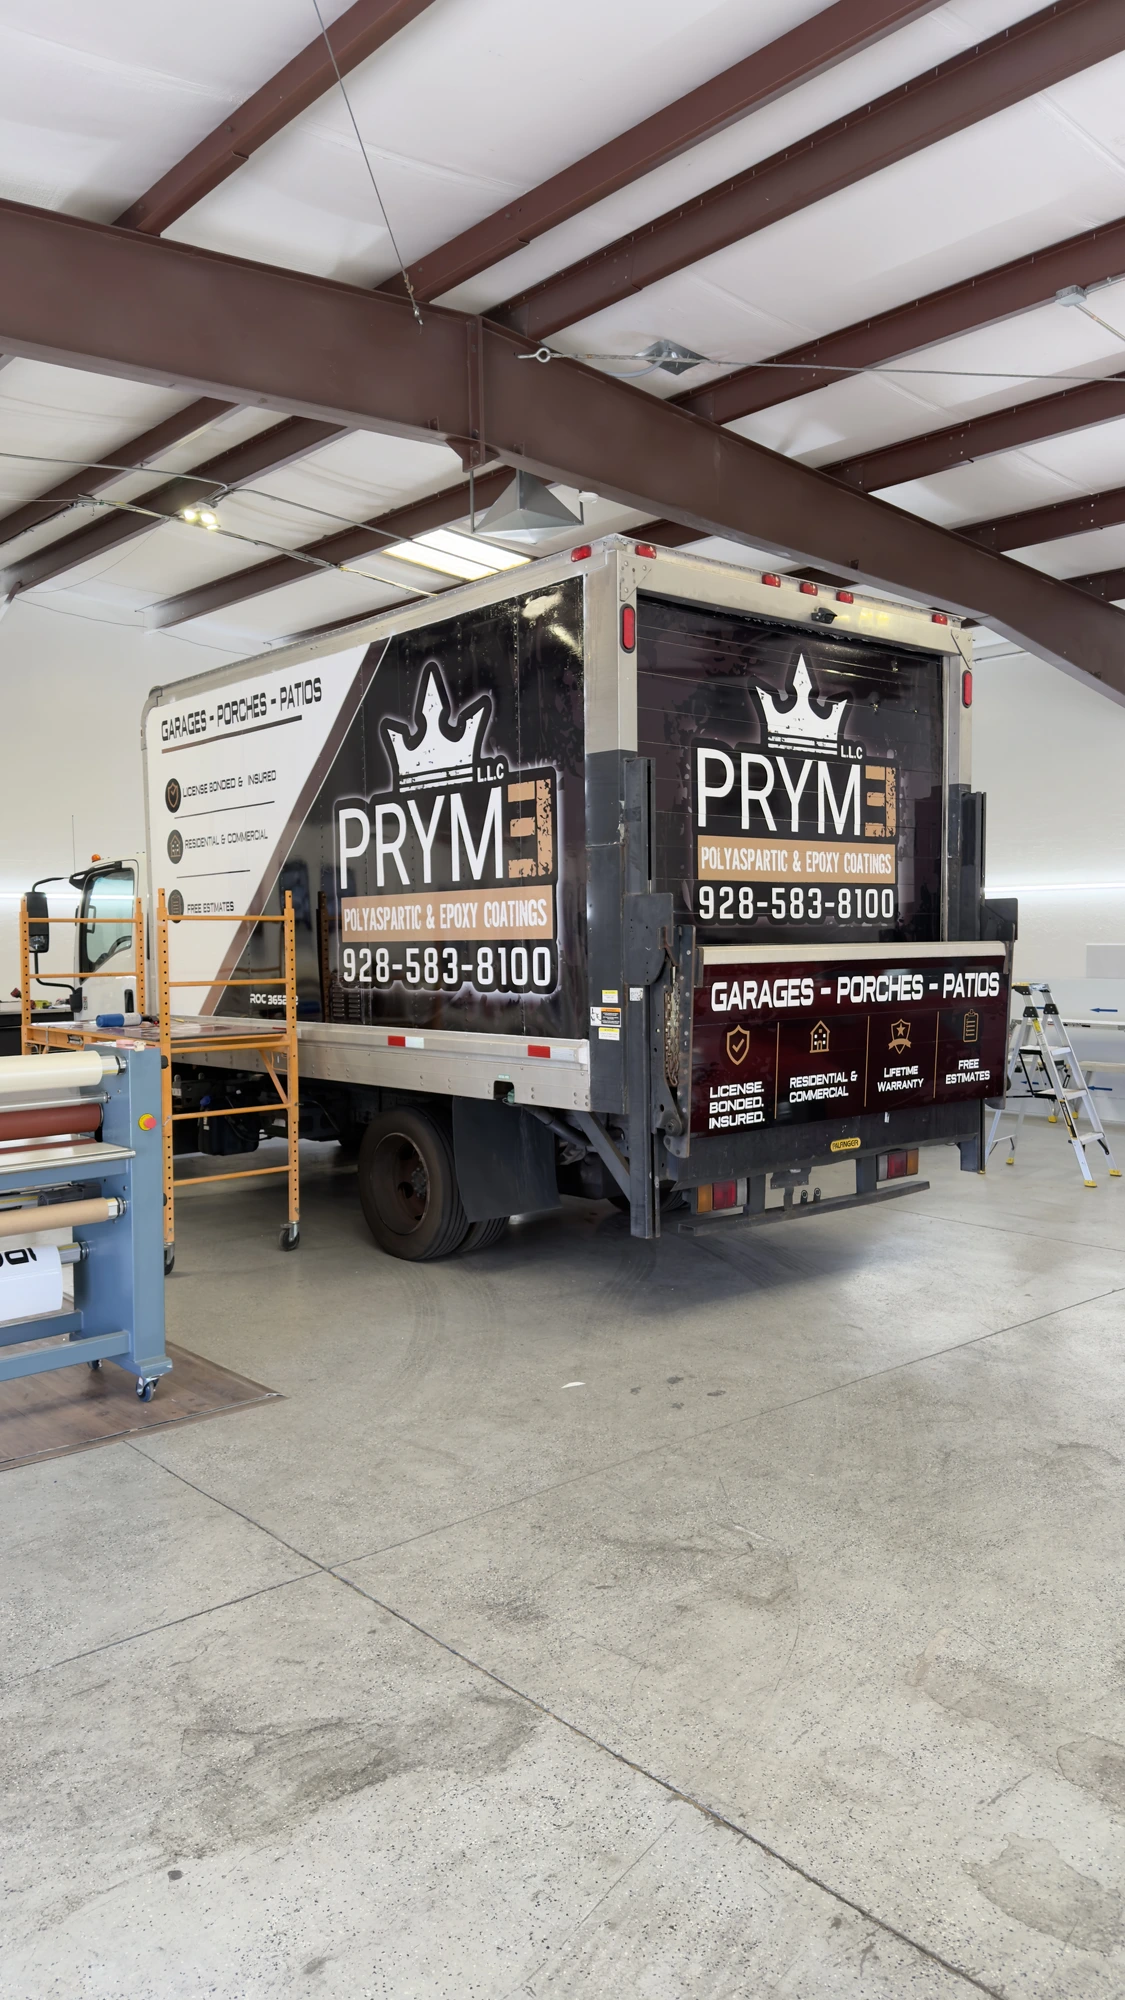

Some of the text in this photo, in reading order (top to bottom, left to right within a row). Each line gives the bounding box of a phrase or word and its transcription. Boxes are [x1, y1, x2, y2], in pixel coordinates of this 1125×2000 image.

[161, 709, 207, 741] GARAGES
[217, 692, 267, 727] PORCHES
[280, 677, 322, 711] PATIOS
[182, 770, 276, 798] LICENSE BONDED & INSURED
[697, 747, 897, 838] PRYME
[185, 829, 268, 849] RESIDENTIAL & COMMERCIAL
[338, 778, 553, 890] PRYME
[701, 846, 892, 875] POLYASPARTIC & EPOXY COATINGS
[187, 901, 235, 914] FREE ESTIMATES
[699, 885, 894, 920] 928-583-8100
[344, 898, 548, 932] POLYASPARTIC & EPOXY COATINGS
[343, 947, 551, 986] 928-583-8100
[250, 993, 266, 1004] ROC
[711, 978, 814, 1012] GARAGES
[837, 974, 924, 1004] PORCHES
[942, 972, 1000, 999] PATIOS
[883, 1065, 919, 1078] LIFETIME
[958, 1058, 980, 1070] FREE
[789, 1070, 858, 1089] RESIDENTIAL &
[877, 1078, 924, 1093] WARRANTY
[945, 1070, 990, 1085] ESTIMATES
[709, 1081, 765, 1099] LICENSE.
[789, 1085, 849, 1103] COMMERCIAL
[709, 1096, 765, 1114] BONDED.
[708, 1111, 765, 1130] INSURED.
